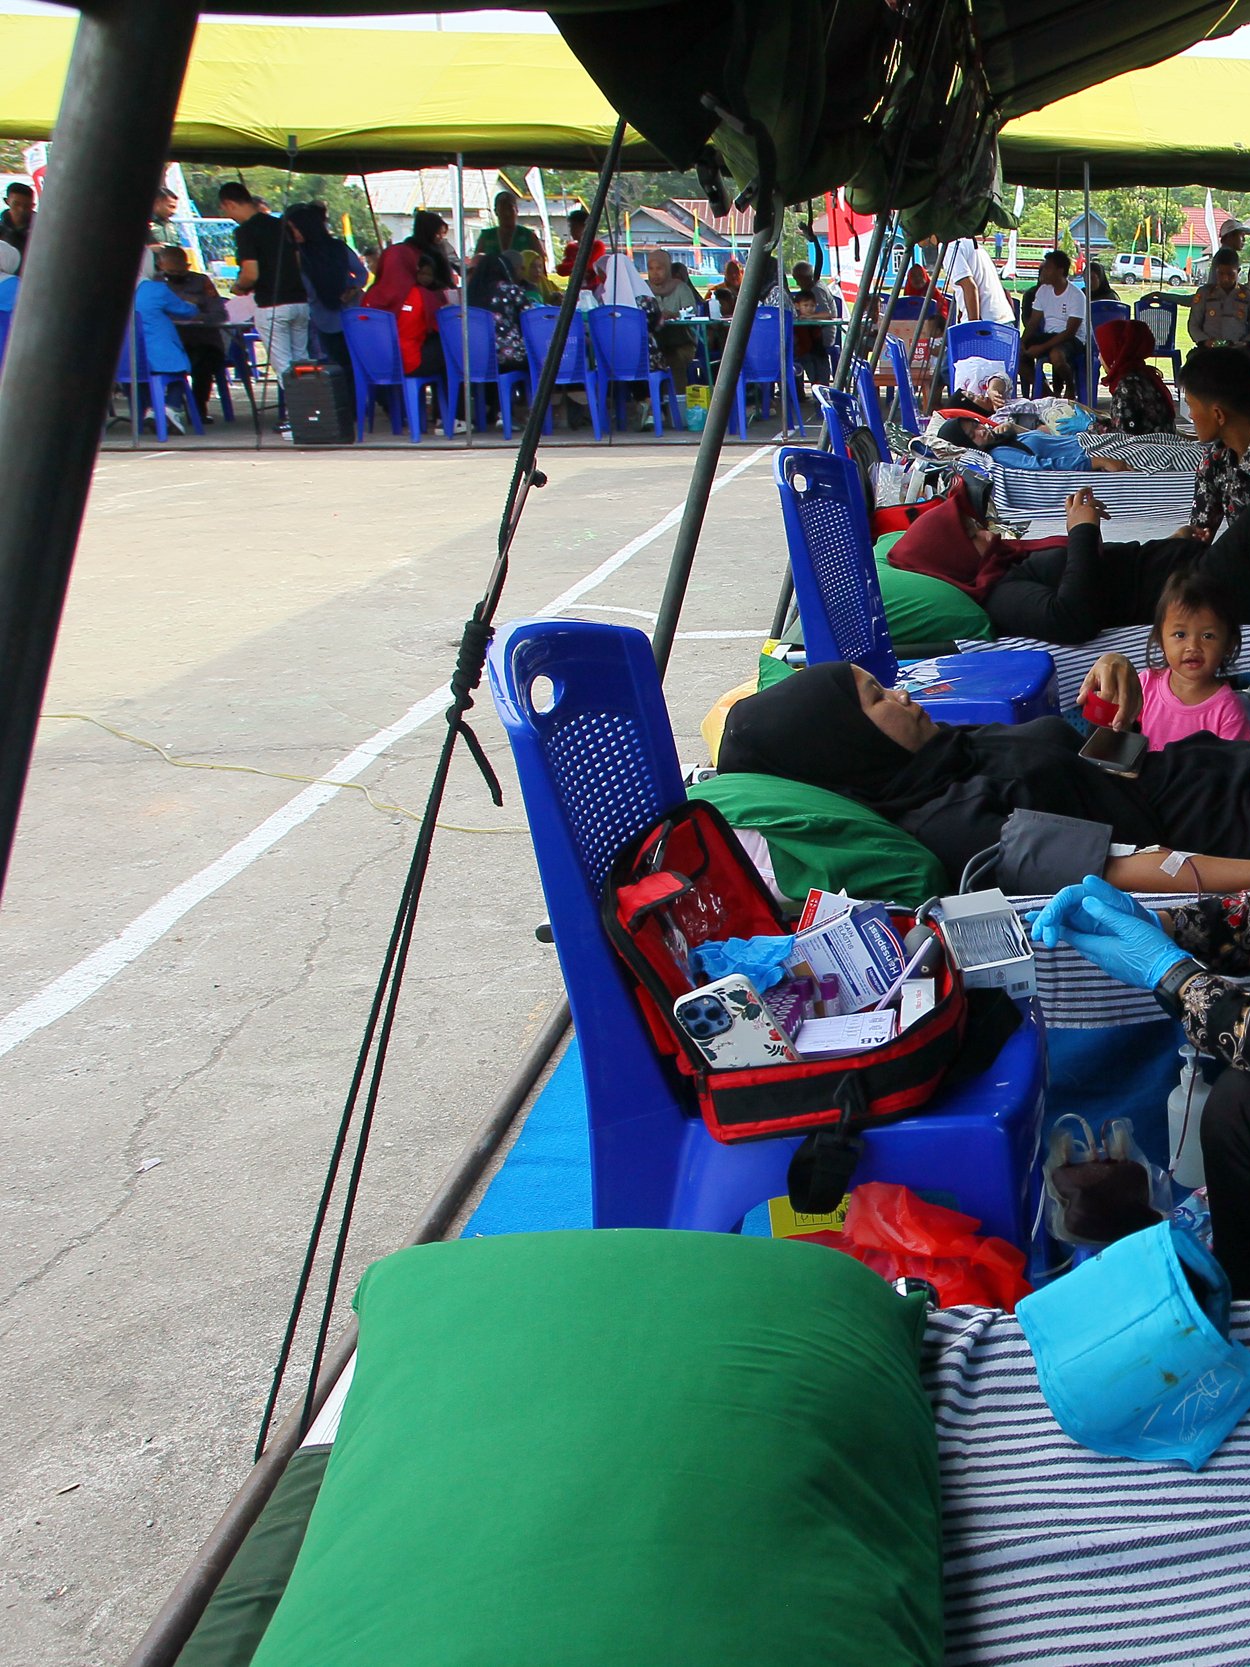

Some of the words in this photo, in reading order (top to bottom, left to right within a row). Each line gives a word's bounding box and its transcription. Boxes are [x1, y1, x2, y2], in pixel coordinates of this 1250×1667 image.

[837, 925, 854, 950] ELASTIS
[843, 922, 854, 938] KAIN
[867, 924, 900, 975] Hansaplast
[860, 1036, 886, 1044] AB
